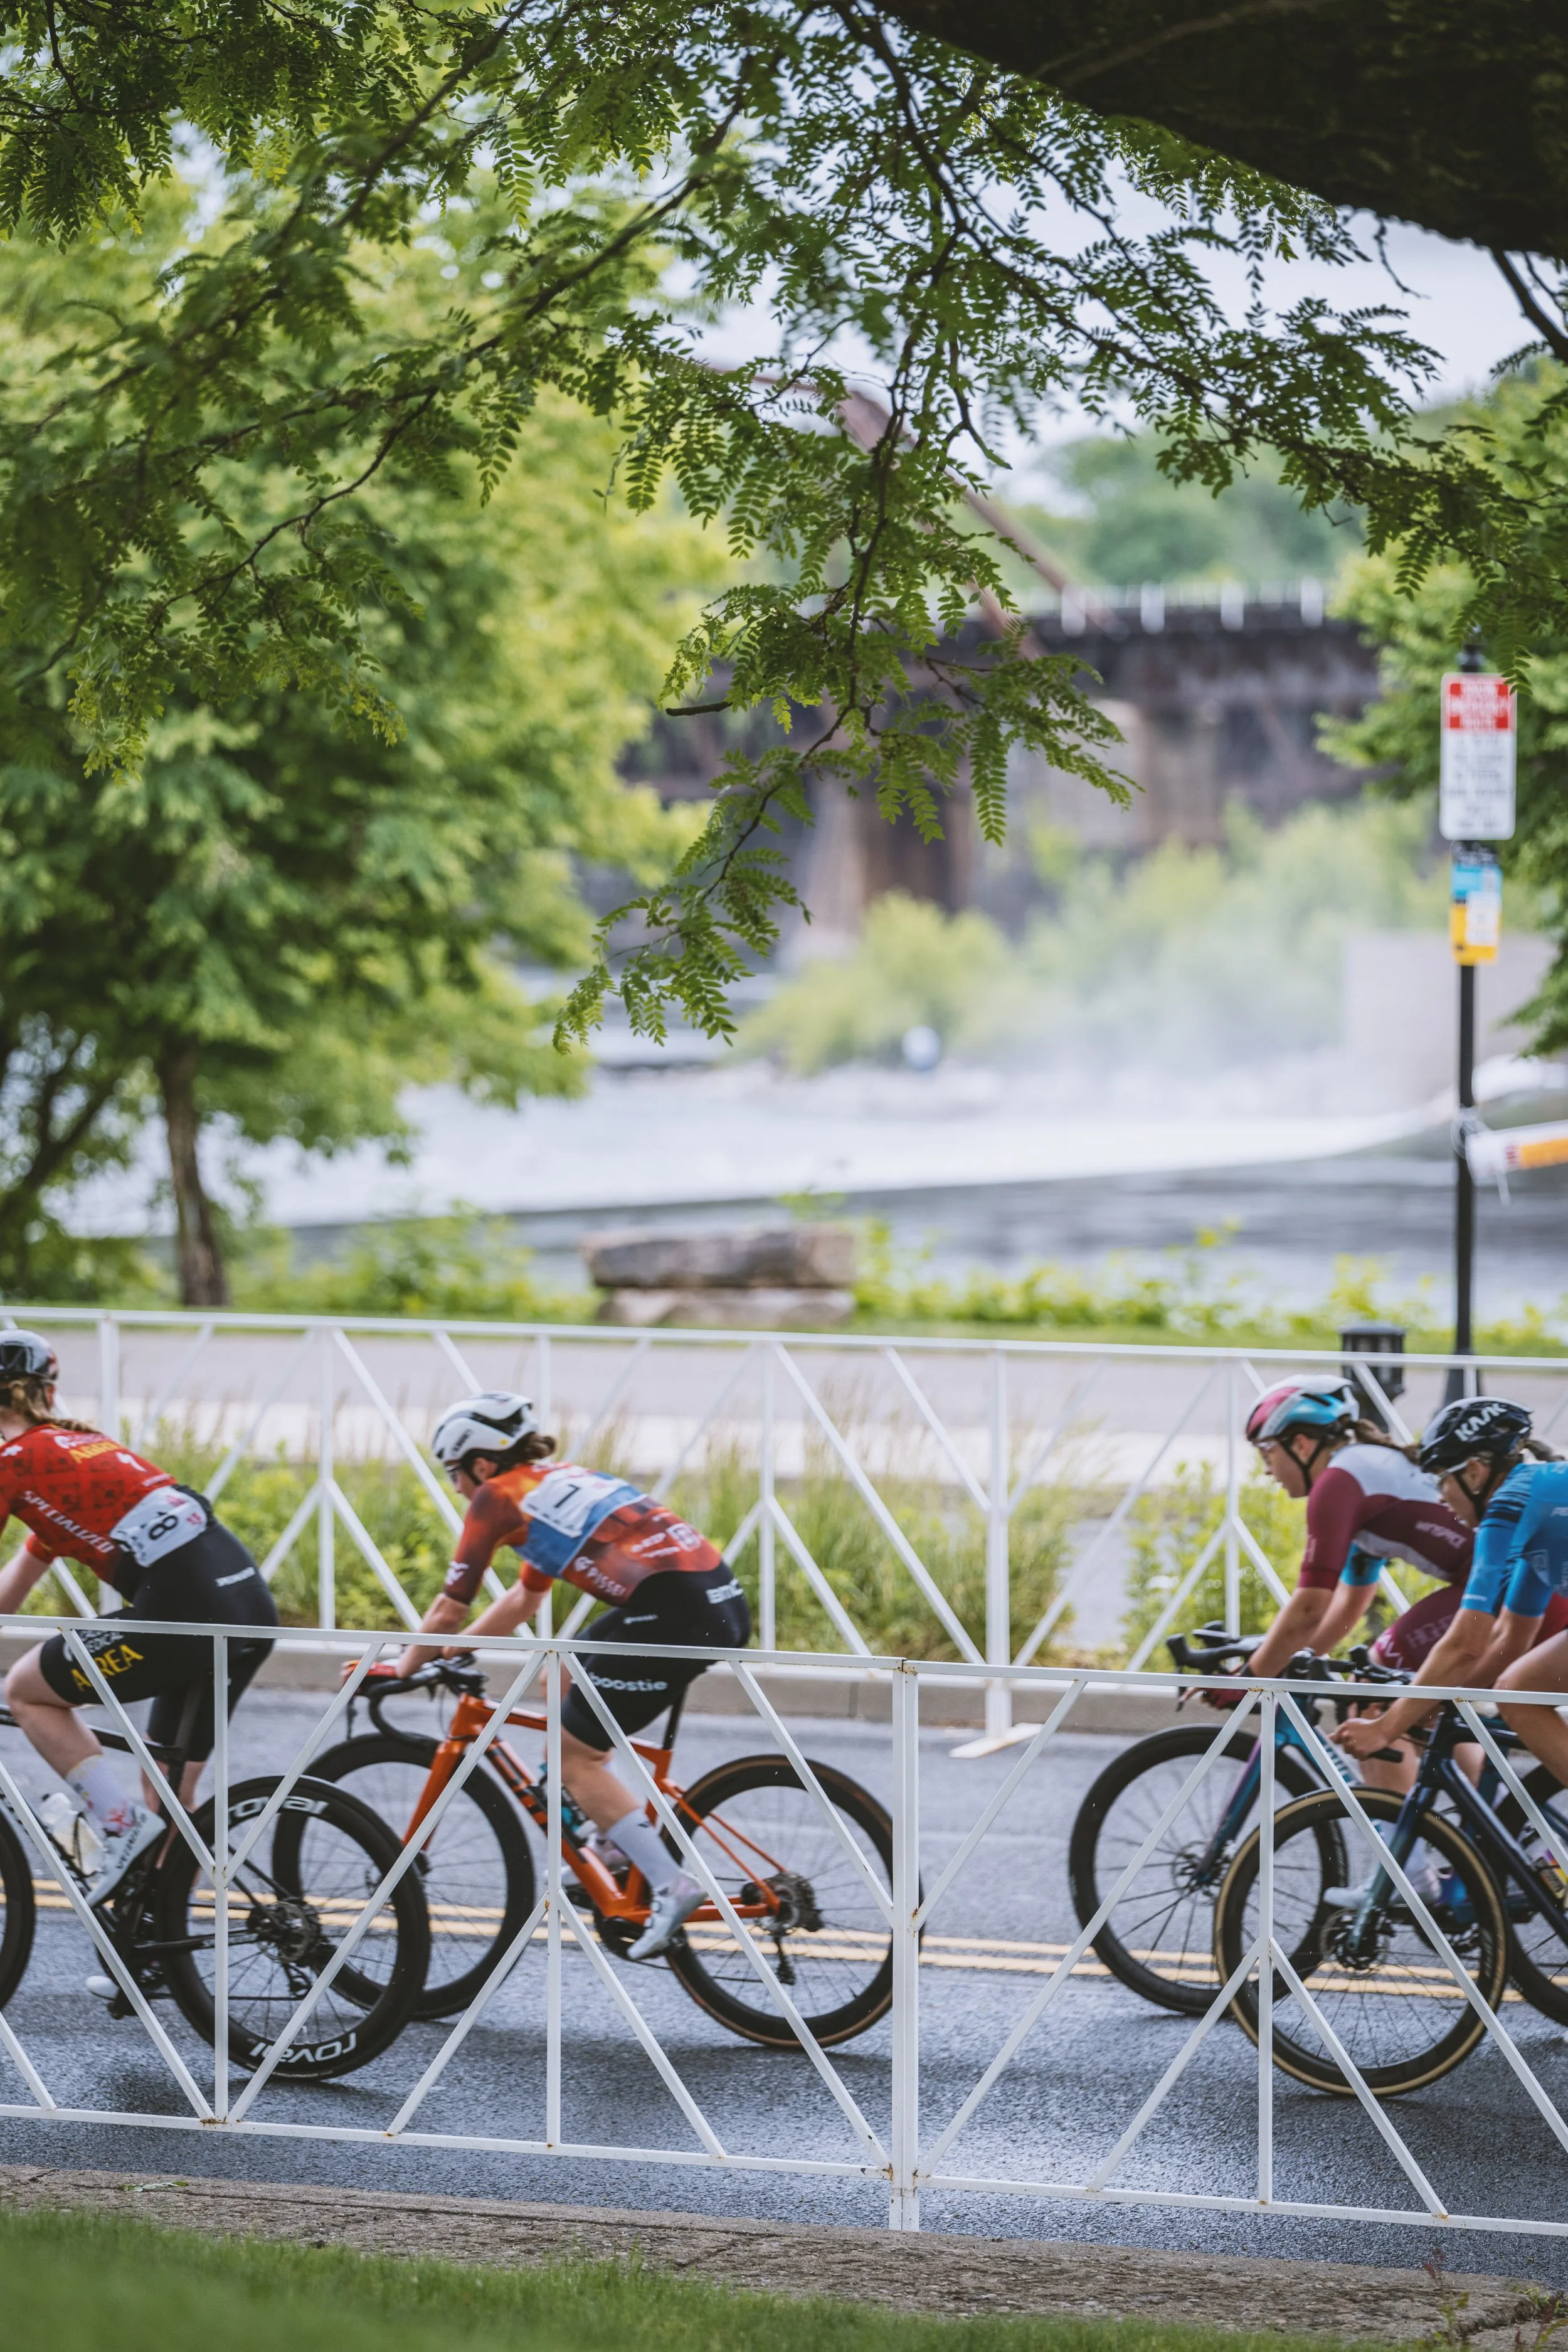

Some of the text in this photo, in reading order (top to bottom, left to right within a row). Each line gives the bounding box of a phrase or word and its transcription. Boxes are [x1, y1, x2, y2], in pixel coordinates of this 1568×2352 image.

[1454, 1403, 1507, 1441] KASK
[553, 1484, 581, 1508] 1
[23, 1490, 115, 1553] SPECIALIZED
[70, 1644, 144, 1692] AREA
[228, 1796, 329, 1825] roal
